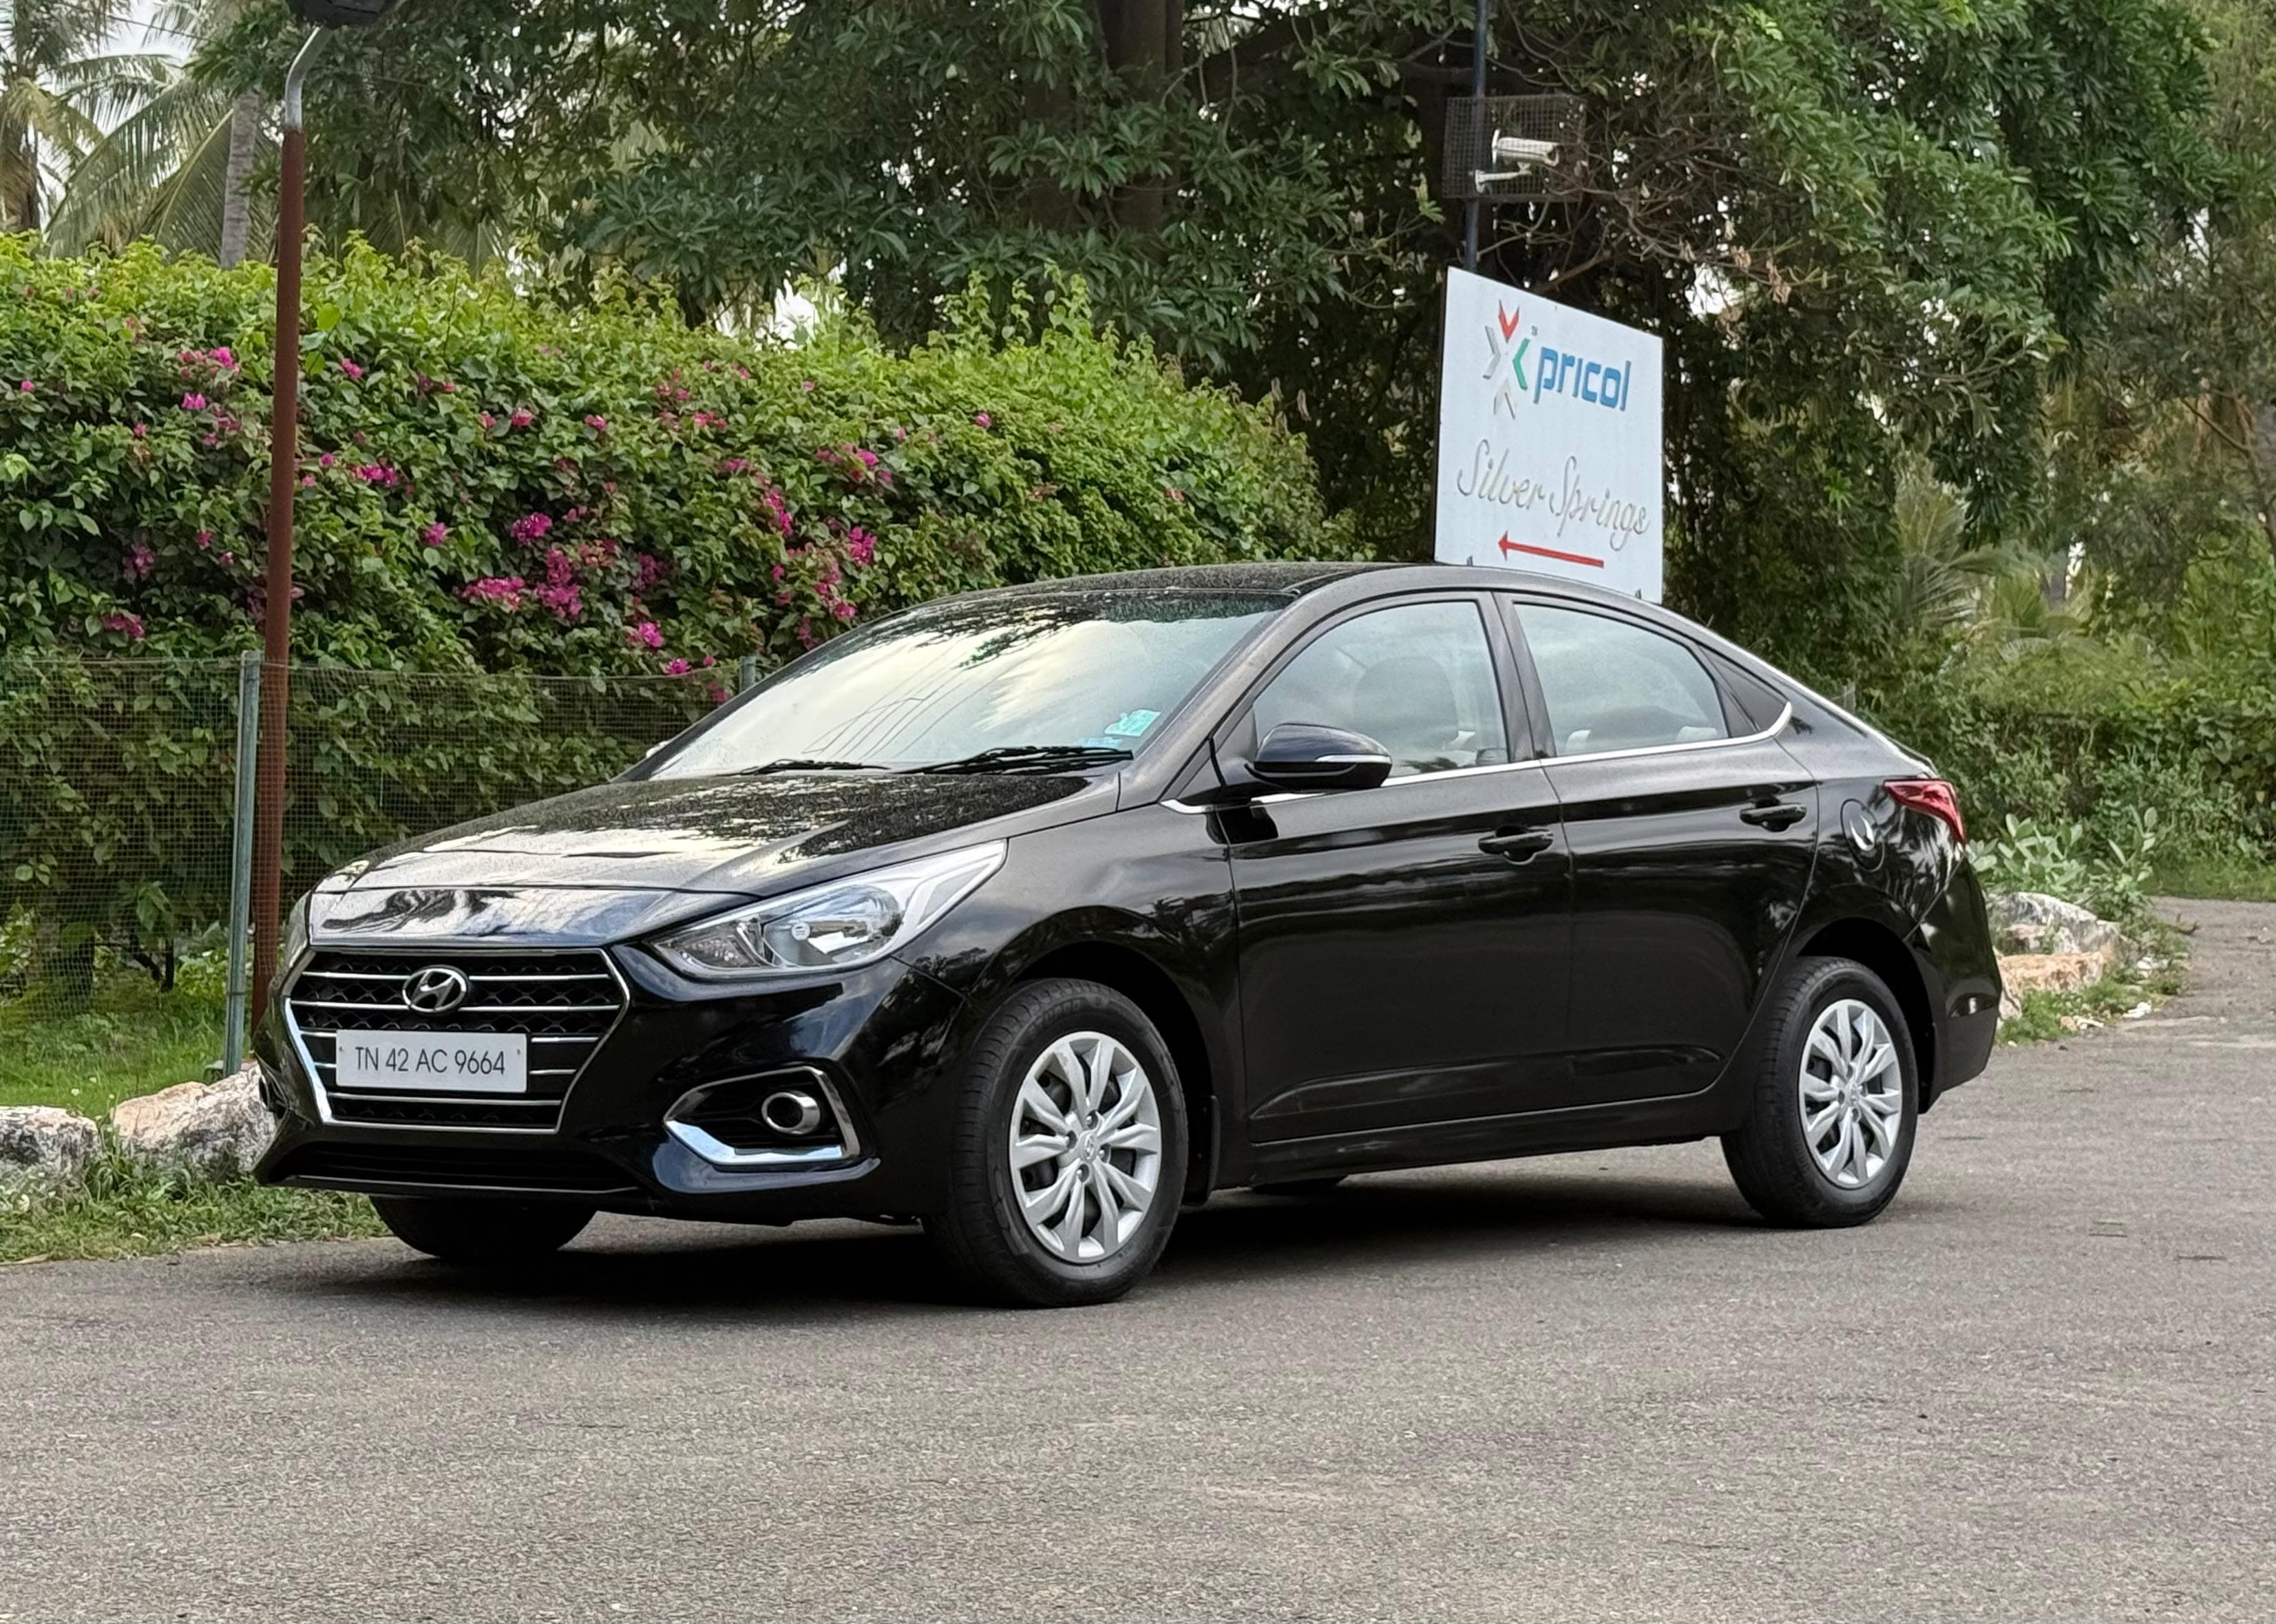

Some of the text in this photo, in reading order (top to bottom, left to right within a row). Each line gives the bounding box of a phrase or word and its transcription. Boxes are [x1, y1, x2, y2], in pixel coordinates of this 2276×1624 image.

[1533, 346, 1631, 412] pricol
[1457, 439, 1651, 551] Silver Springs
[355, 1046, 505, 1075] TN 42 AC 9664
